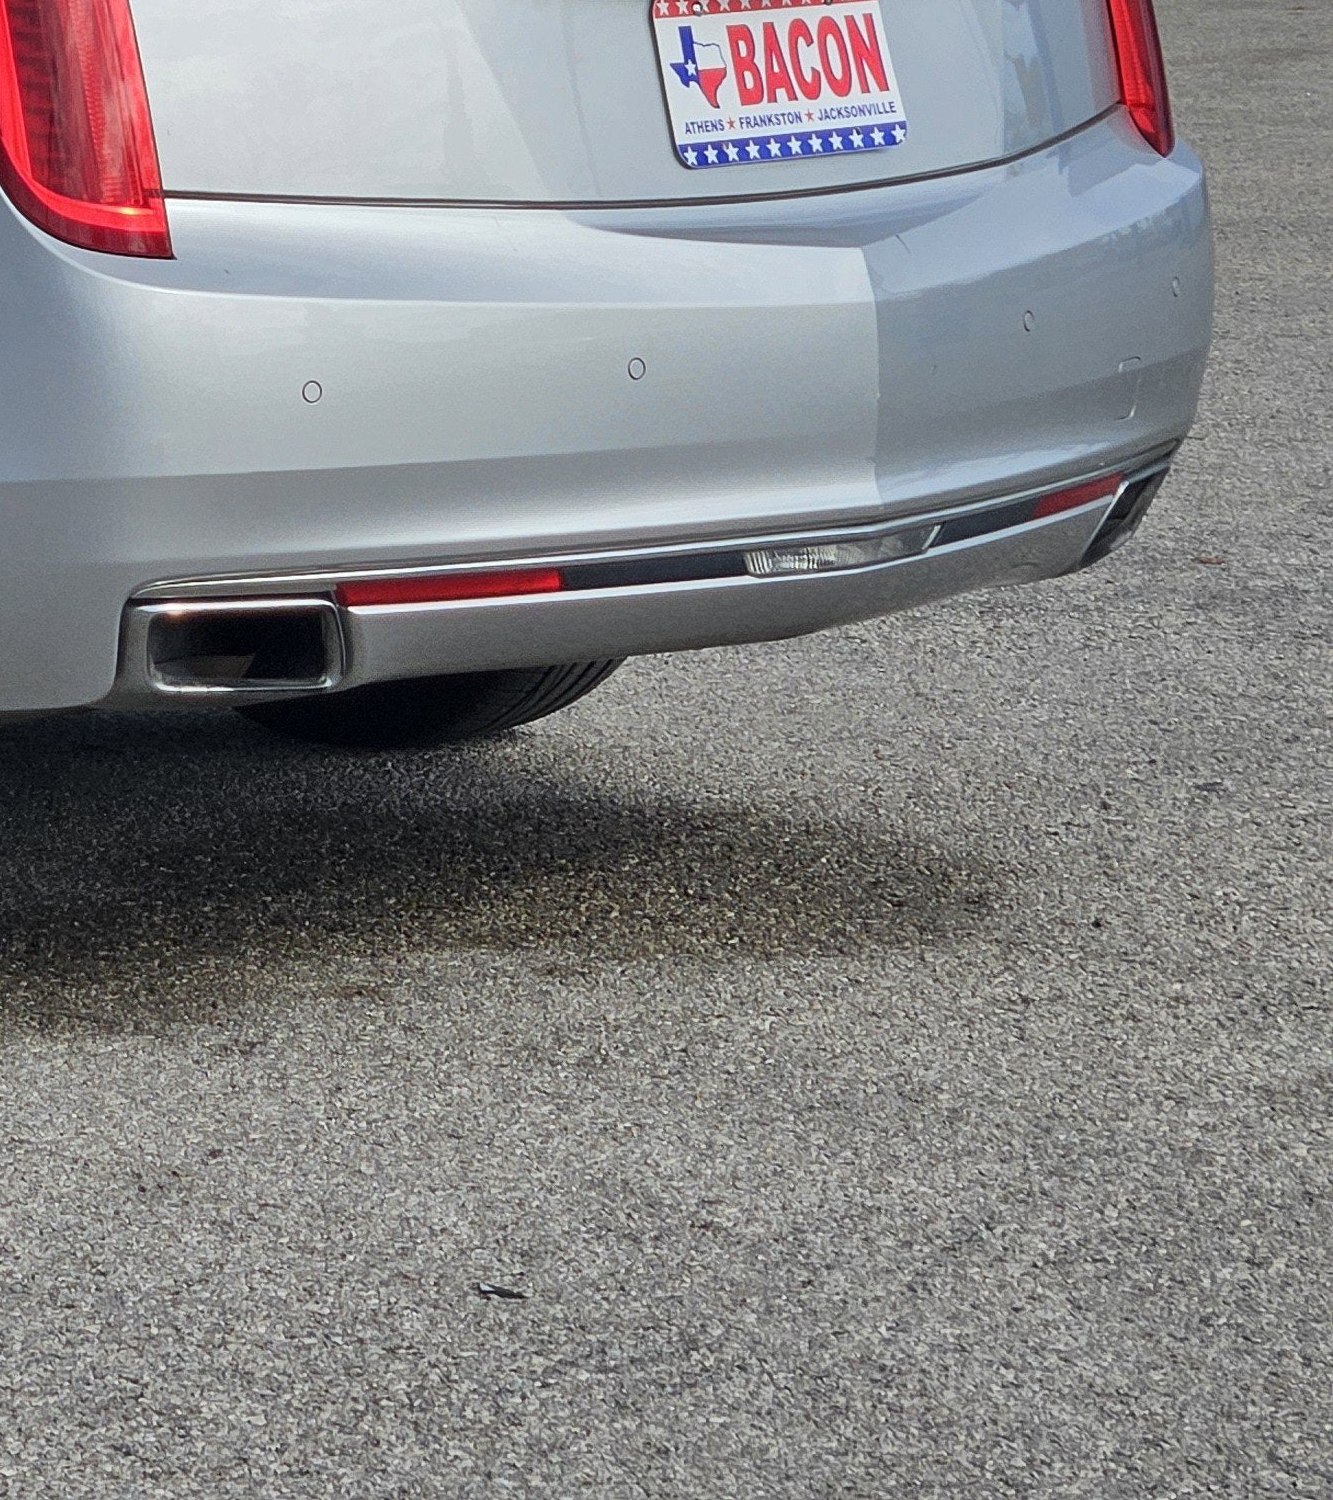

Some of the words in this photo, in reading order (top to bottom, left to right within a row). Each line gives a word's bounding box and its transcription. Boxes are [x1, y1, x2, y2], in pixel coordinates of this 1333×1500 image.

[726, 13, 890, 106] BACON
[684, 118, 725, 135] ATHENS
[739, 111, 803, 129] FRANKSTON
[817, 101, 897, 122] JACKSONVILLE
